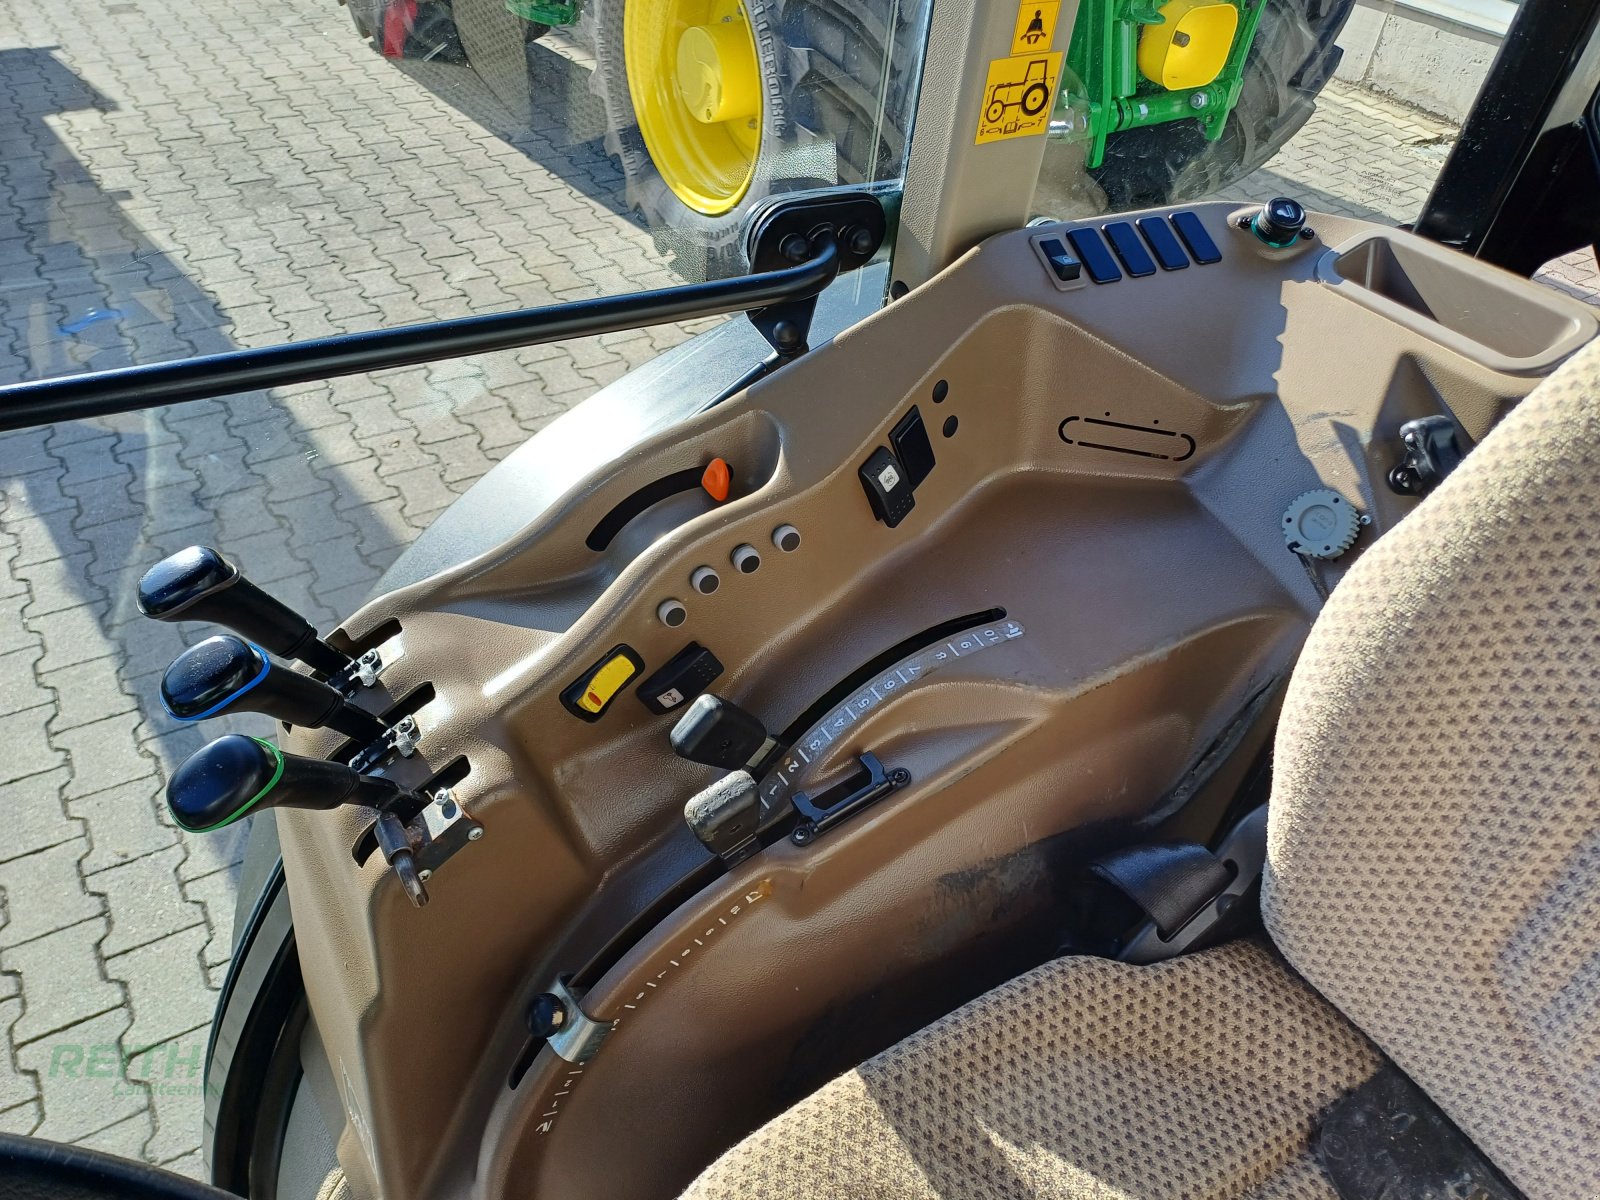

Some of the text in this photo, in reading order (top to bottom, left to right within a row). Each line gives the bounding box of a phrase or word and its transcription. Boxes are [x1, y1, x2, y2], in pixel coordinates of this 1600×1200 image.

[788, 761, 800, 773] 2
[809, 740, 821, 751] 3
[834, 718, 845, 727] 4
[858, 698, 870, 709] 5
[884, 680, 896, 690] 6
[908, 664, 921, 674] 7
[935, 651, 947, 660] 8
[960, 640, 972, 650] 9
[983, 629, 999, 642] 10
